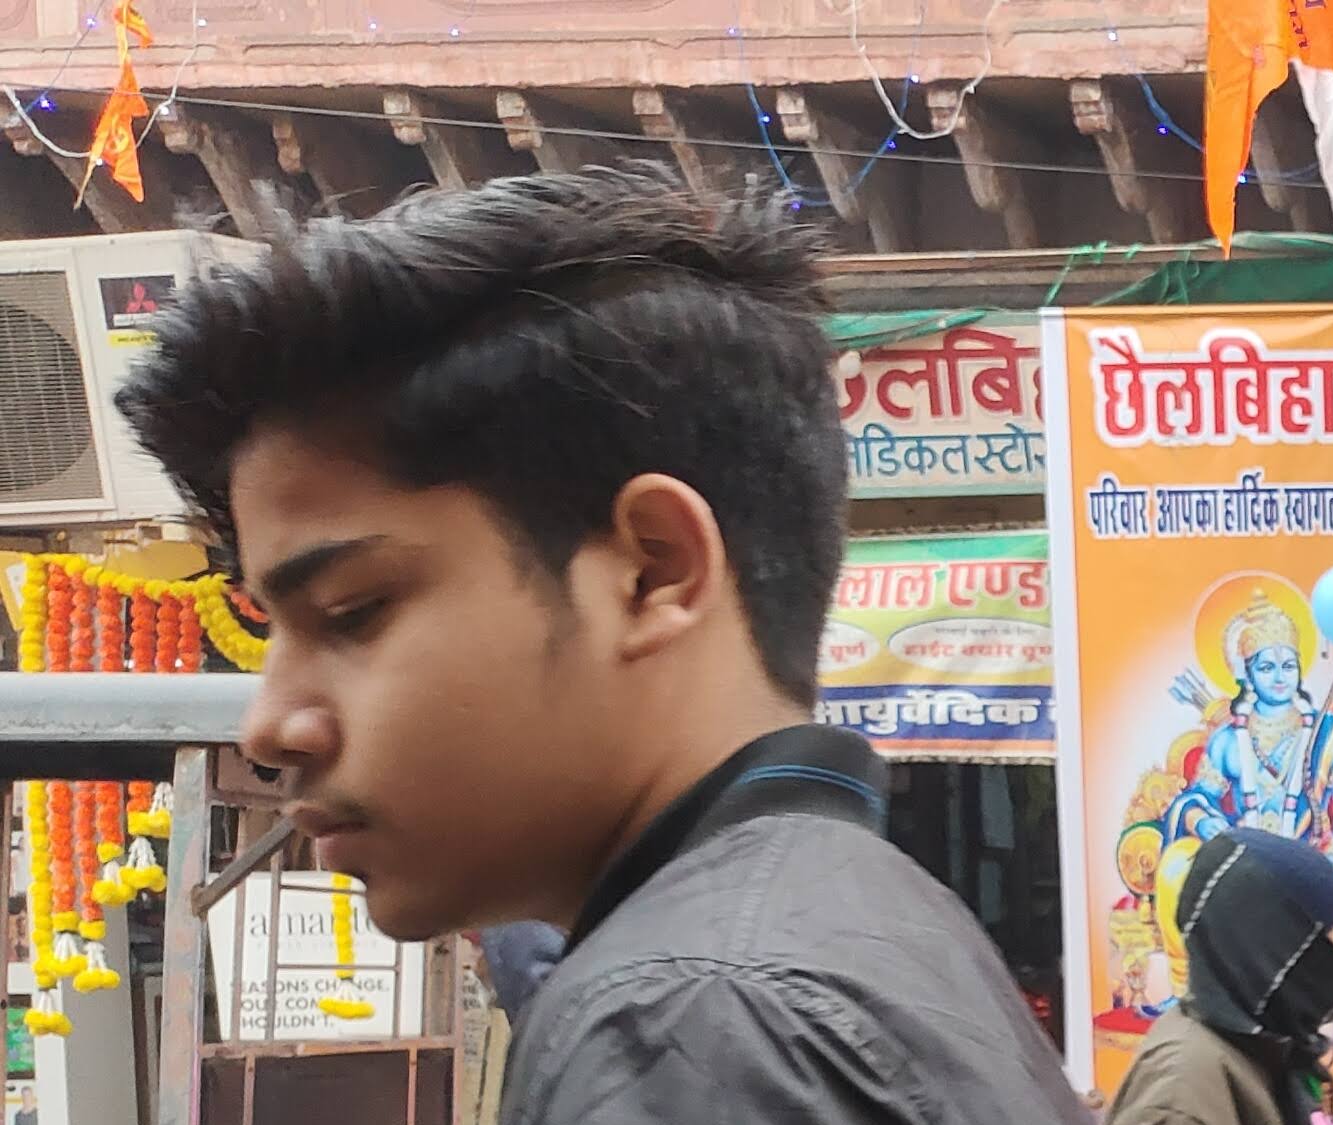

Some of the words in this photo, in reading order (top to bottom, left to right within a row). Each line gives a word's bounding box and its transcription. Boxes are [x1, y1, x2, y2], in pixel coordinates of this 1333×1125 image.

[1089, 478, 1149, 535] परिवार
[1222, 472, 1280, 533] हार्दिक
[948, 561, 1047, 608] एण्ड
